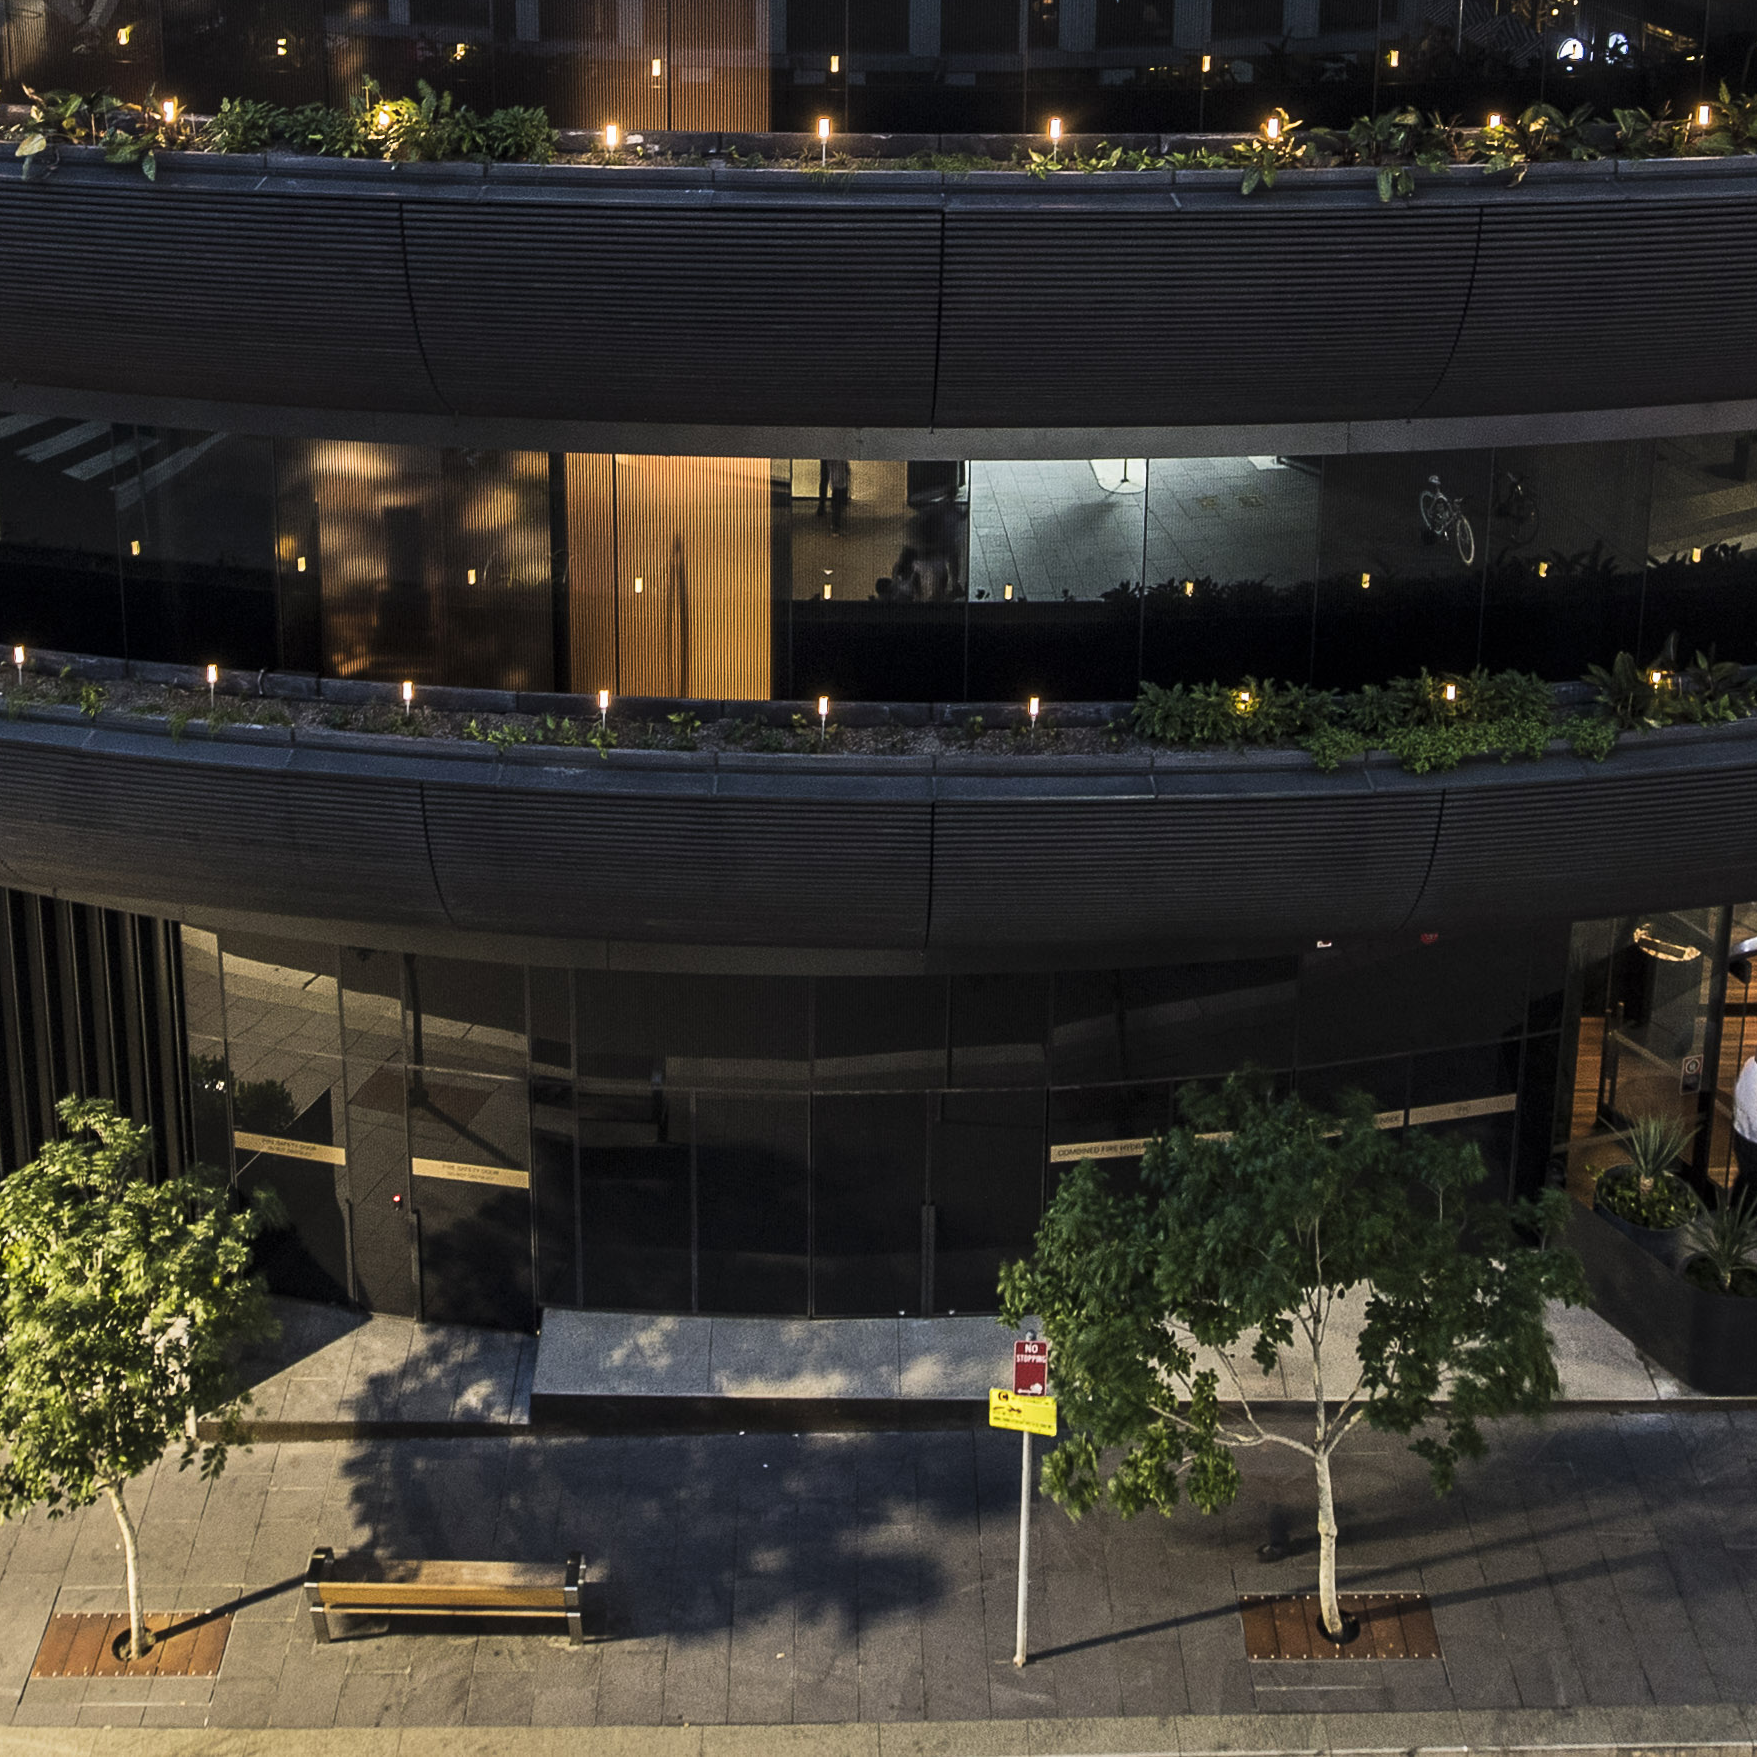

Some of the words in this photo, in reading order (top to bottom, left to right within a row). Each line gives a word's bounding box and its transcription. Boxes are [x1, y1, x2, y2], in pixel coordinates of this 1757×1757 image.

[1057, 1146, 1100, 1157] COMBINED
[1101, 1144, 1118, 1153] FIRE
[1119, 1142, 1147, 1152] HYDRA
[1024, 1344, 1038, 1353] NO
[1016, 1354, 1047, 1363] STOPPING
